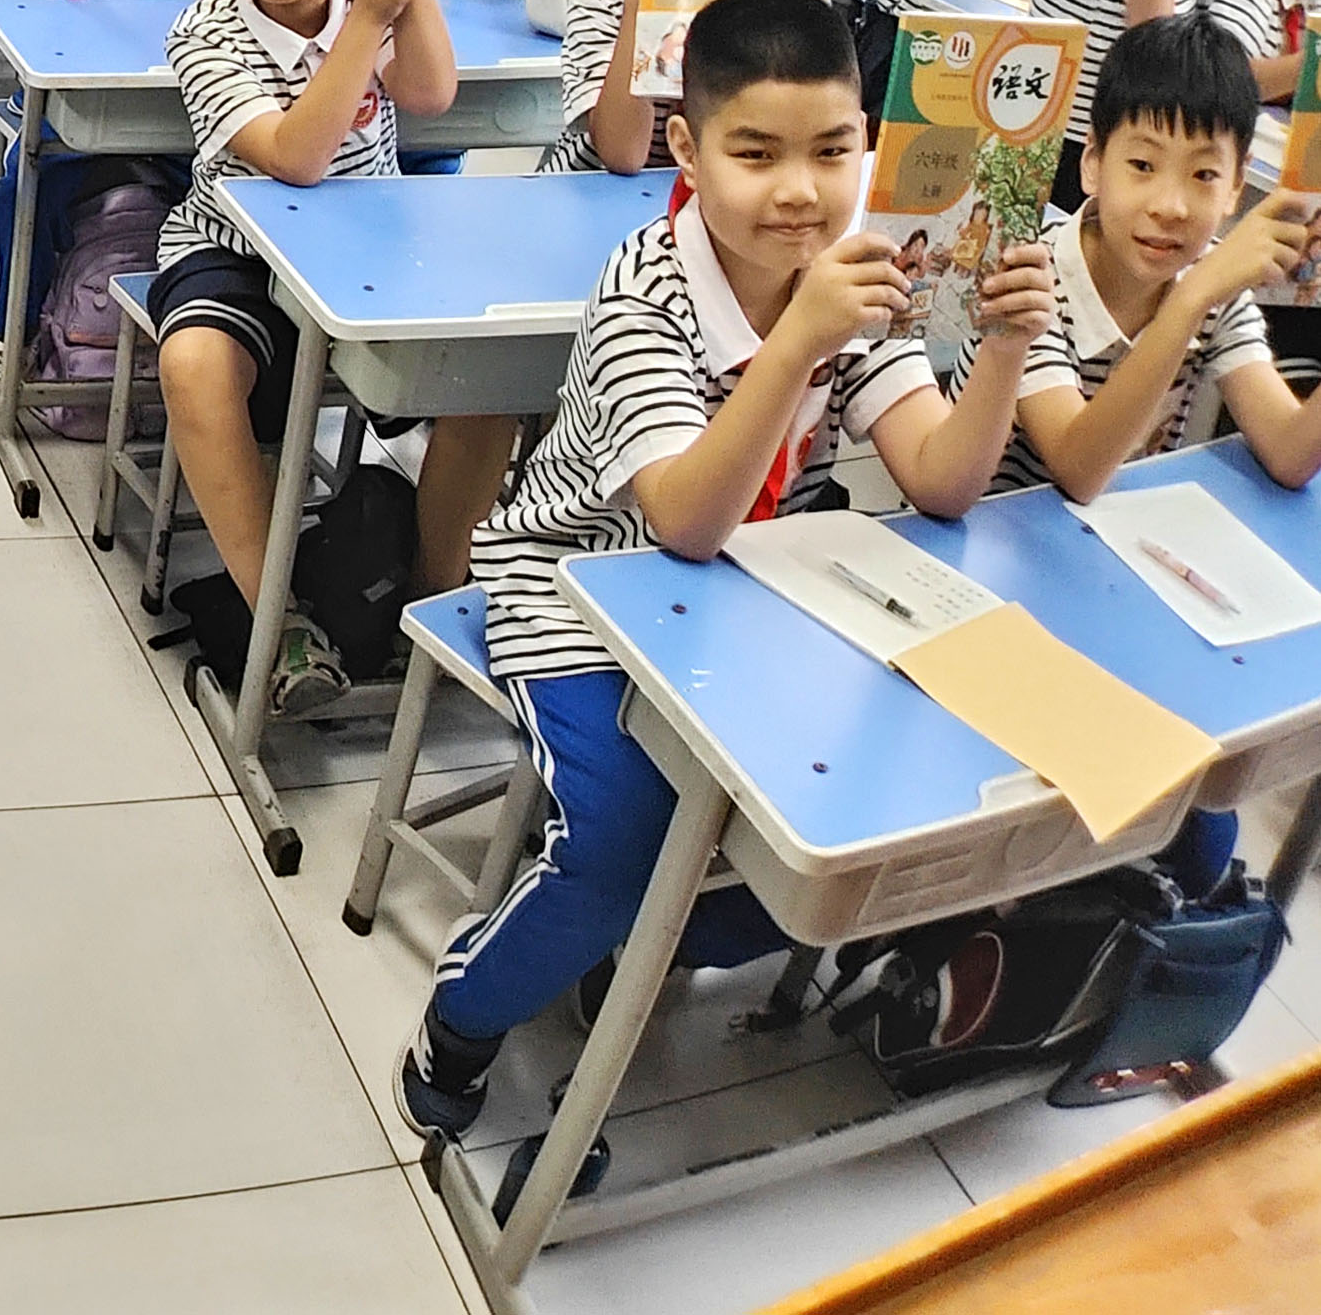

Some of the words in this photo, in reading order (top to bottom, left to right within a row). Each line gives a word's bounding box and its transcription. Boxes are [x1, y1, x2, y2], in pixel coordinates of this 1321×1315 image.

[993, 64, 1051, 100] 语文
[915, 152, 958, 169] 六年级
